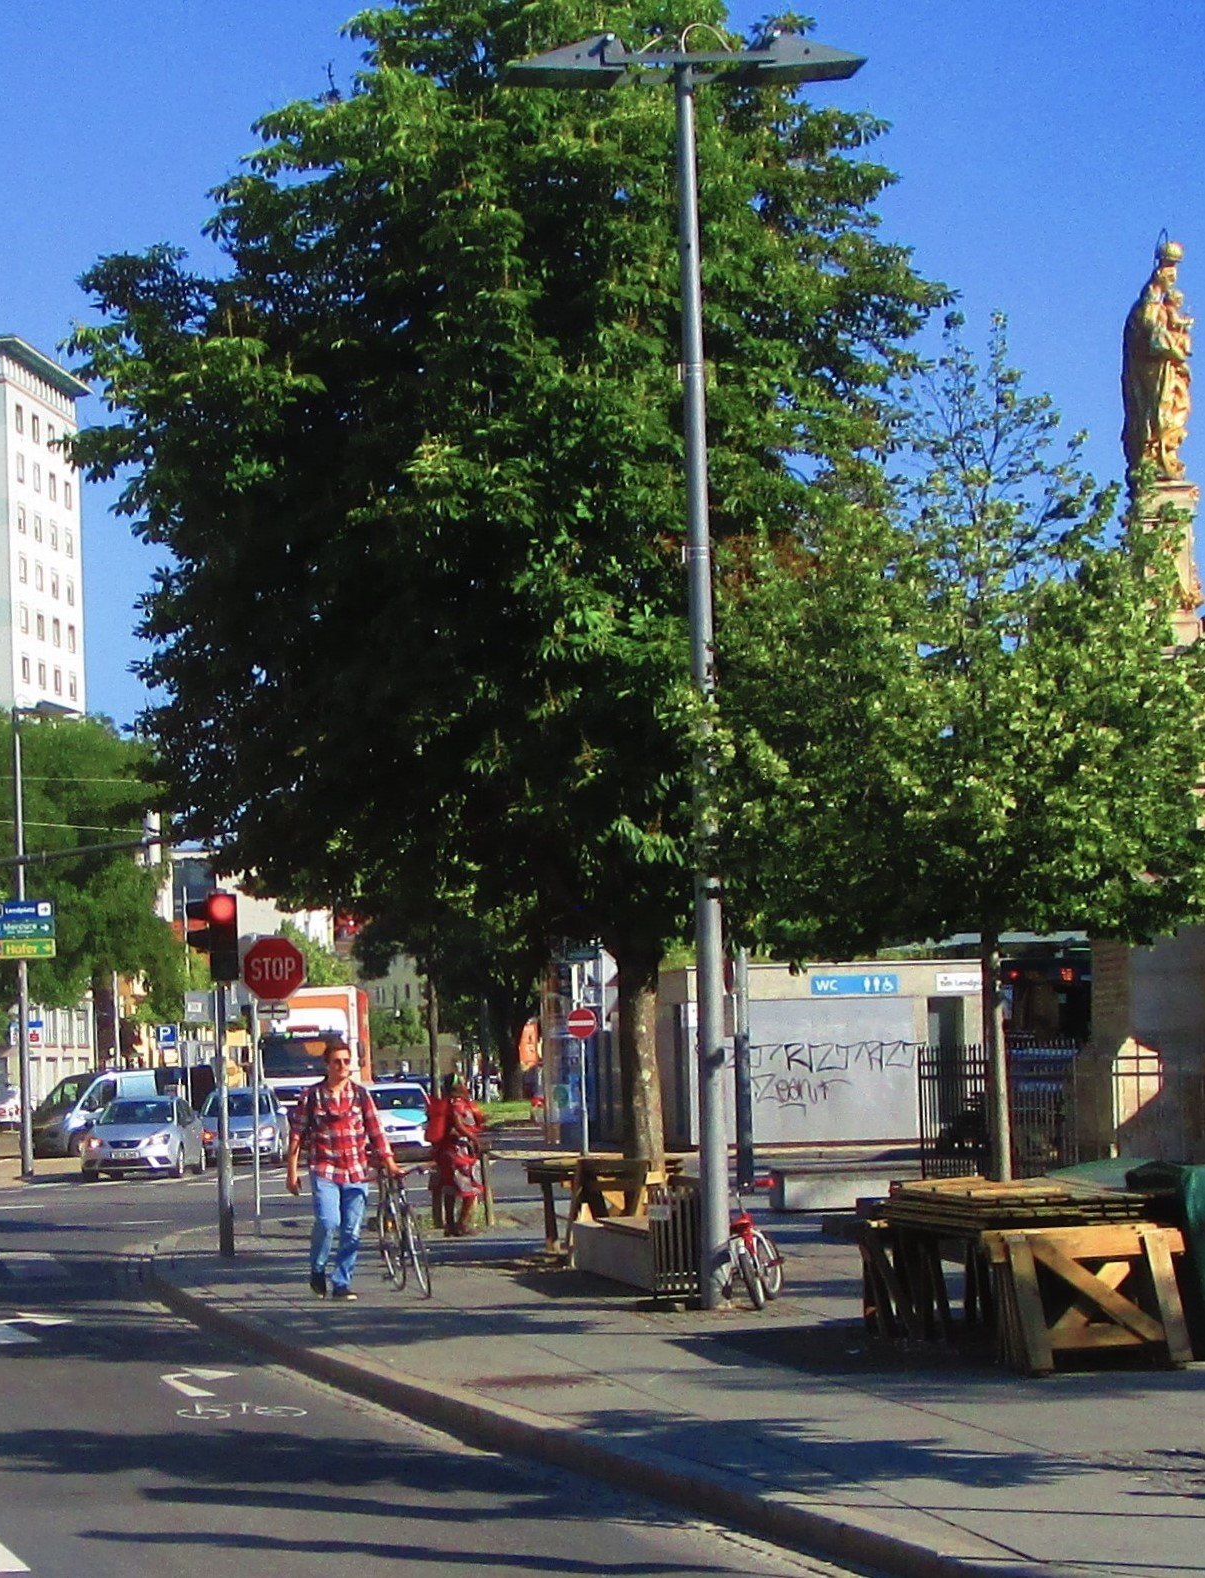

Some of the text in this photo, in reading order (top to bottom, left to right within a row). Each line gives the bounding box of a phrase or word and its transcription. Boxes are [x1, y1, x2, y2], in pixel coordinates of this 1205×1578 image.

[6, 942, 38, 954] Hofer
[250, 957, 296, 981] STOP
[816, 979, 839, 991] WC
[159, 1026, 172, 1042] P
